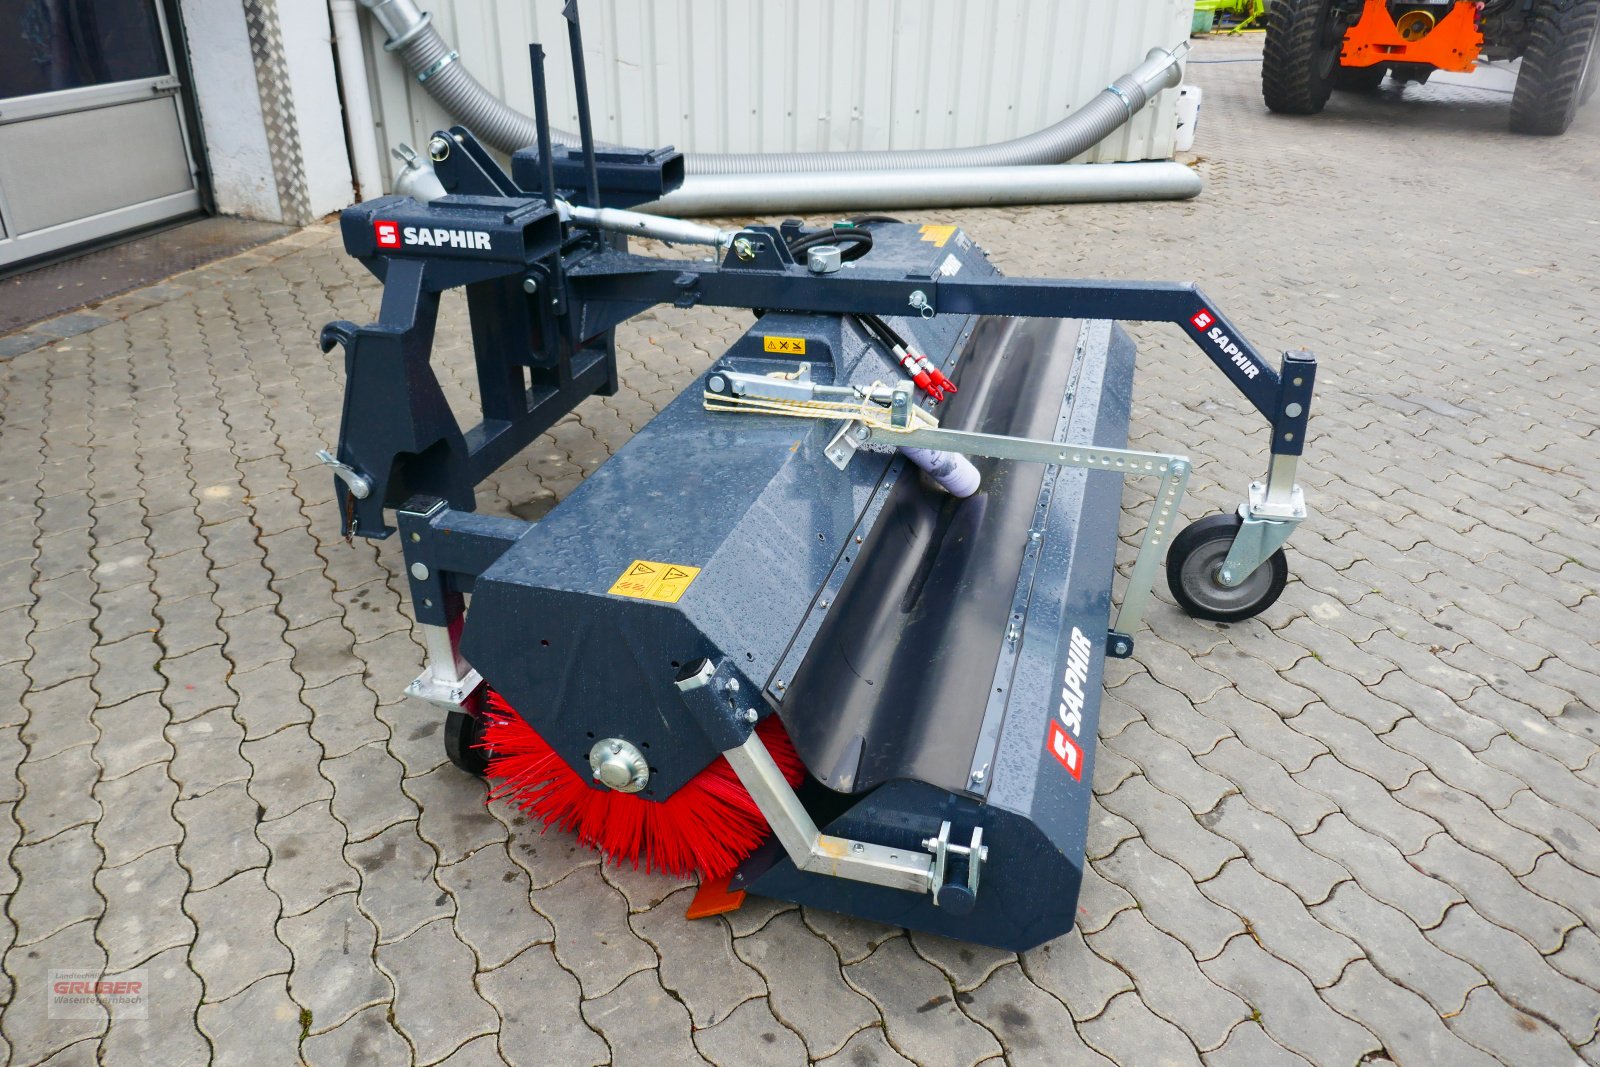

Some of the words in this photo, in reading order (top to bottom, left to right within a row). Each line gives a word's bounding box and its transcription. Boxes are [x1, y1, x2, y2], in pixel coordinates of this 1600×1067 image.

[403, 227, 492, 250] SAPHIR
[1207, 327, 1260, 380] SAPHIR
[1059, 626, 1092, 738] SAPHIR
